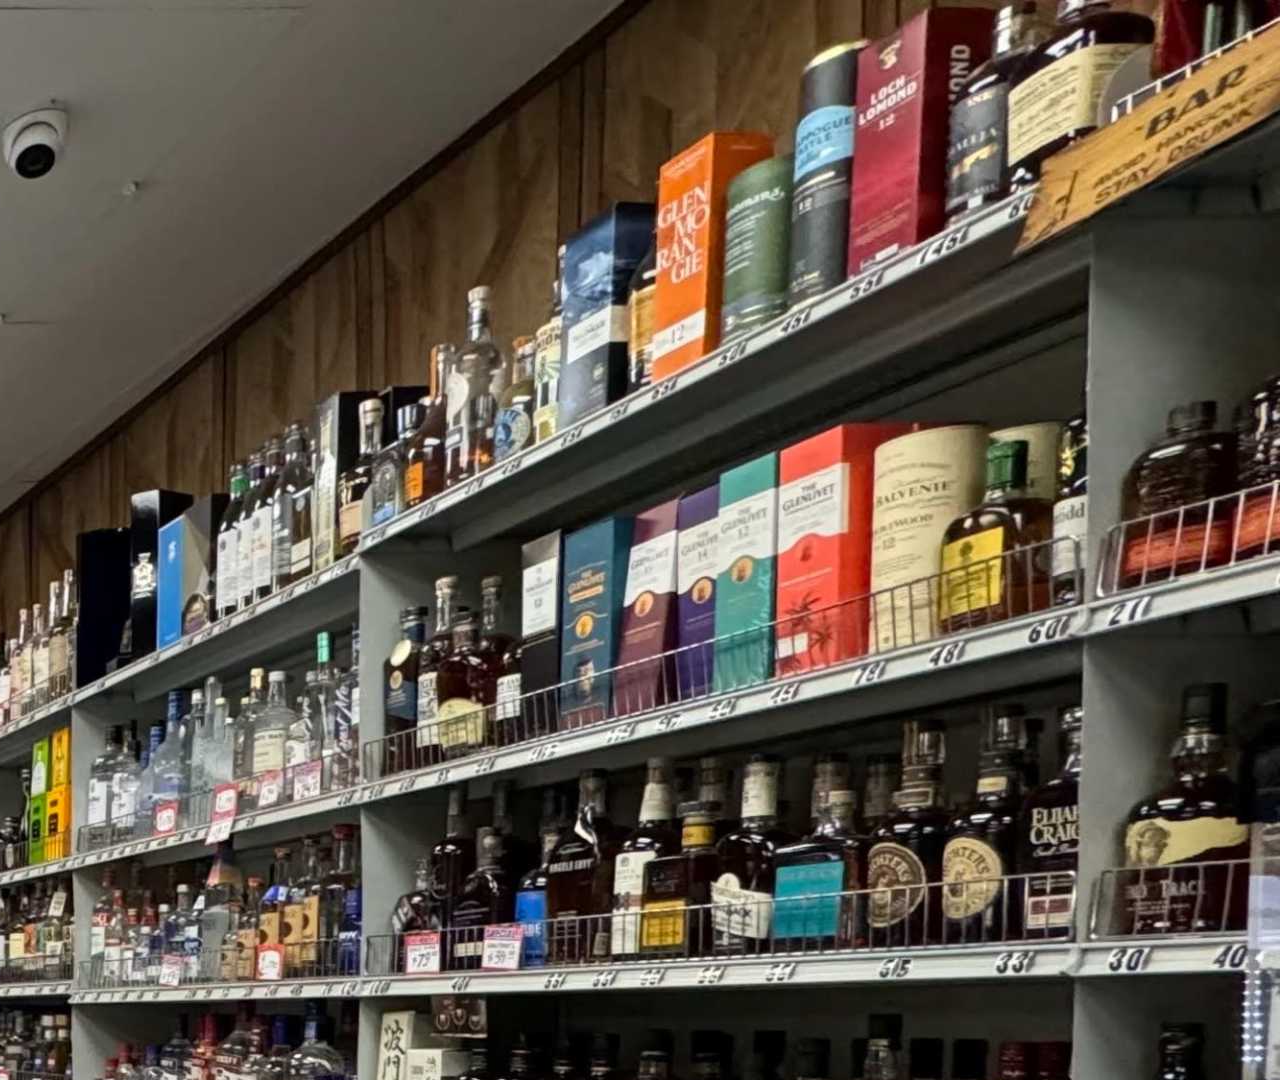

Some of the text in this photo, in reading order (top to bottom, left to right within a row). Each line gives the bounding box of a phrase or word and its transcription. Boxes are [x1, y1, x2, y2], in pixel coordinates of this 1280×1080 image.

[859, 80, 917, 126] LOMOND
[870, 74, 905, 105] LOCH
[1145, 65, 1248, 140] BAR
[1094, 163, 1153, 206] STAY
[658, 180, 709, 228] GLEN
[674, 204, 710, 240] MO
[657, 238, 697, 269] RAN
[671, 252, 702, 284] GIE
[671, 324, 685, 343] 12
[782, 483, 834, 512] GLENLIVET
[801, 482, 816, 494] THE
[720, 508, 768, 534] GLENLIVET
[1109, 950, 1141, 972] 30
[1213, 945, 1247, 968] 40
